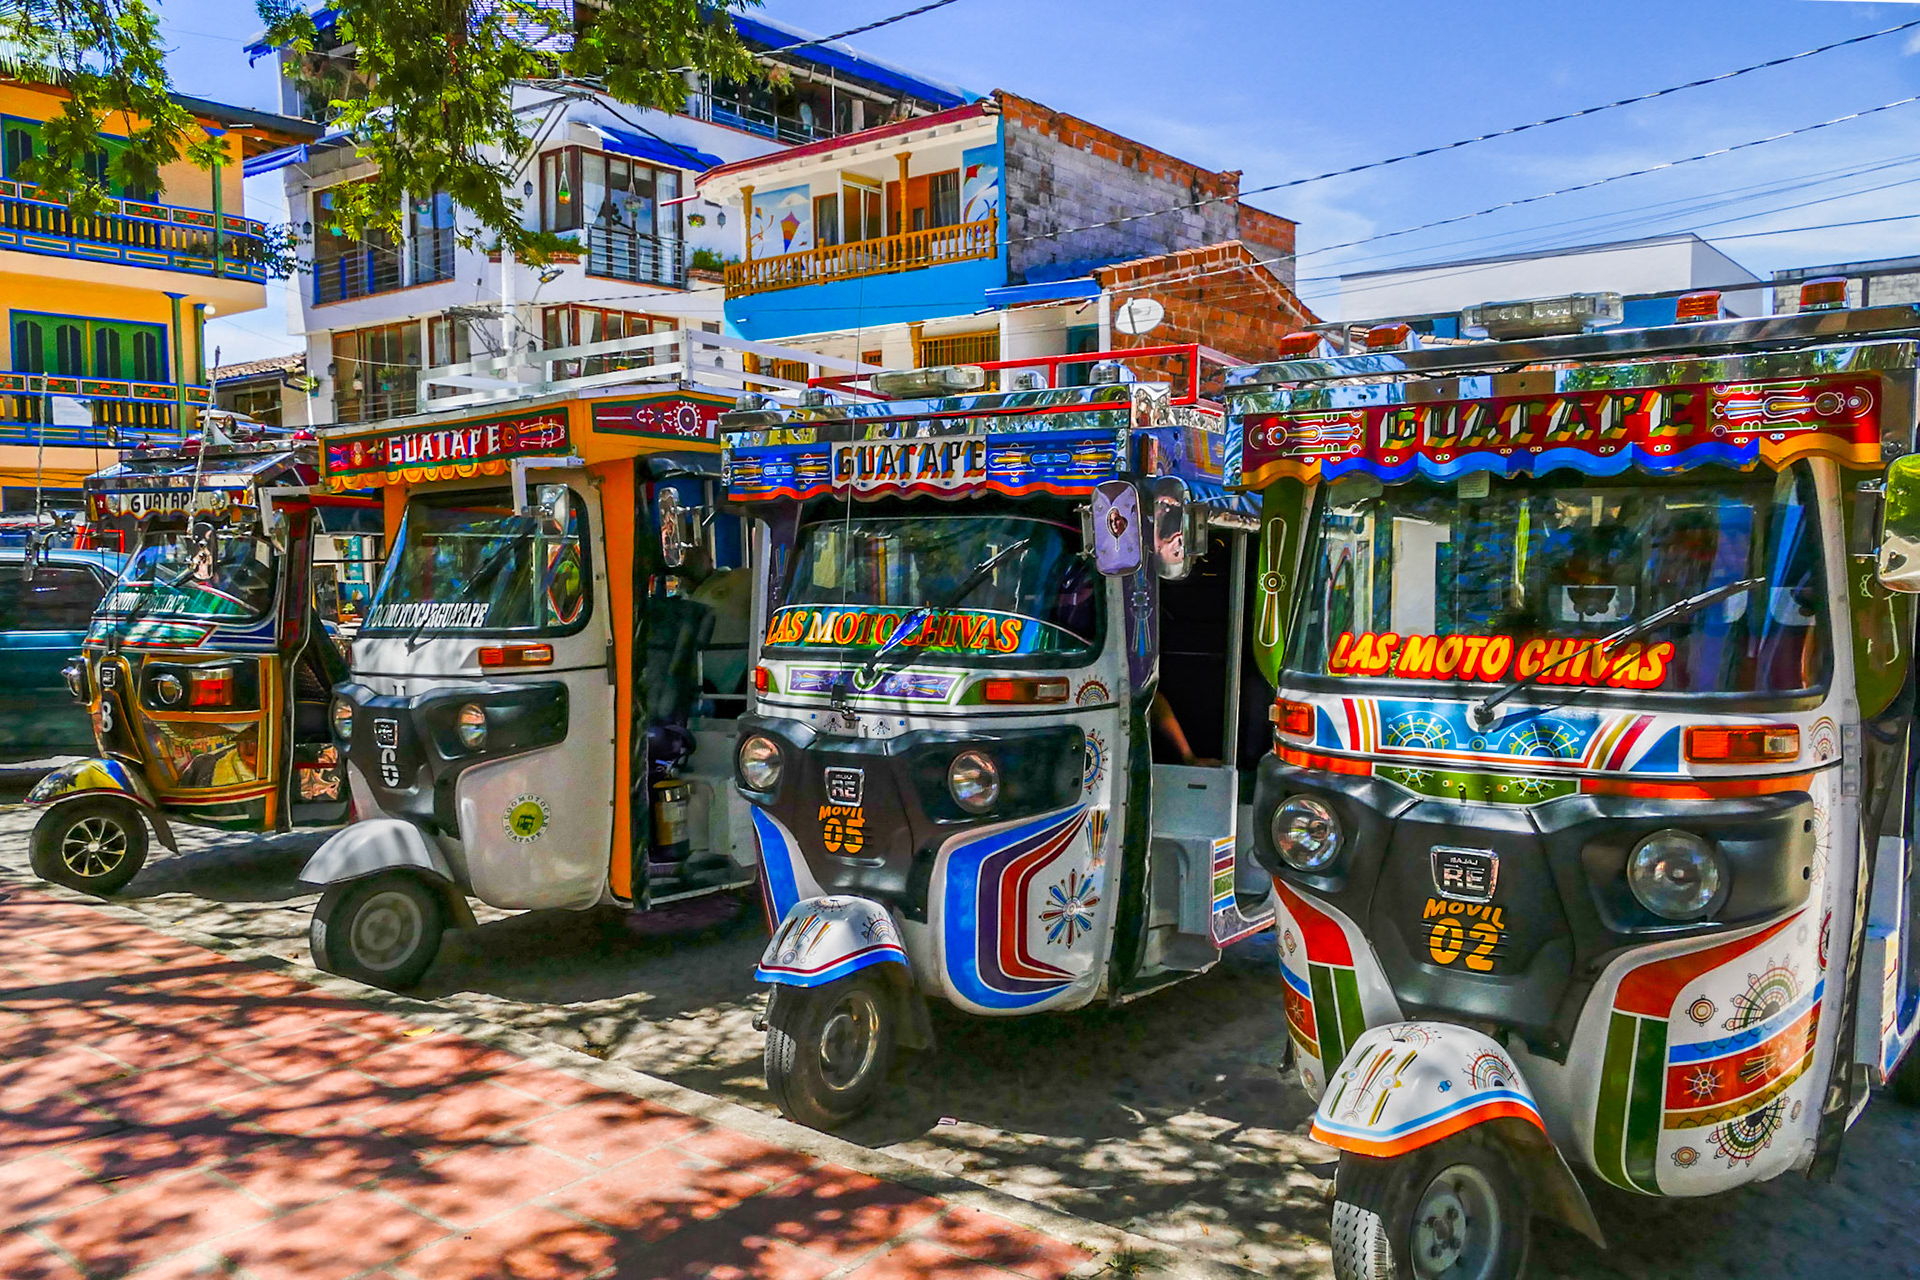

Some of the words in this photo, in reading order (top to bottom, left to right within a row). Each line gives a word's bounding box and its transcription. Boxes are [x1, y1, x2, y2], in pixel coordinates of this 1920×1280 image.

[1380, 390, 1694, 448] GUATAPE
[388, 425, 501, 463] GUATAPE
[834, 440, 987, 482] GUATAPE
[765, 611, 807, 646] LAS
[807, 612, 900, 645] MOTO
[1329, 632, 1399, 676] LAS
[1394, 634, 1514, 682] MOTO
[1514, 637, 1675, 689] CHIVAS
[818, 805, 866, 824] MOVIL
[823, 818, 864, 854] 05
[1443, 863, 1485, 891] RE
[1422, 898, 1505, 930] MOVIL
[1429, 917, 1499, 971] 02
